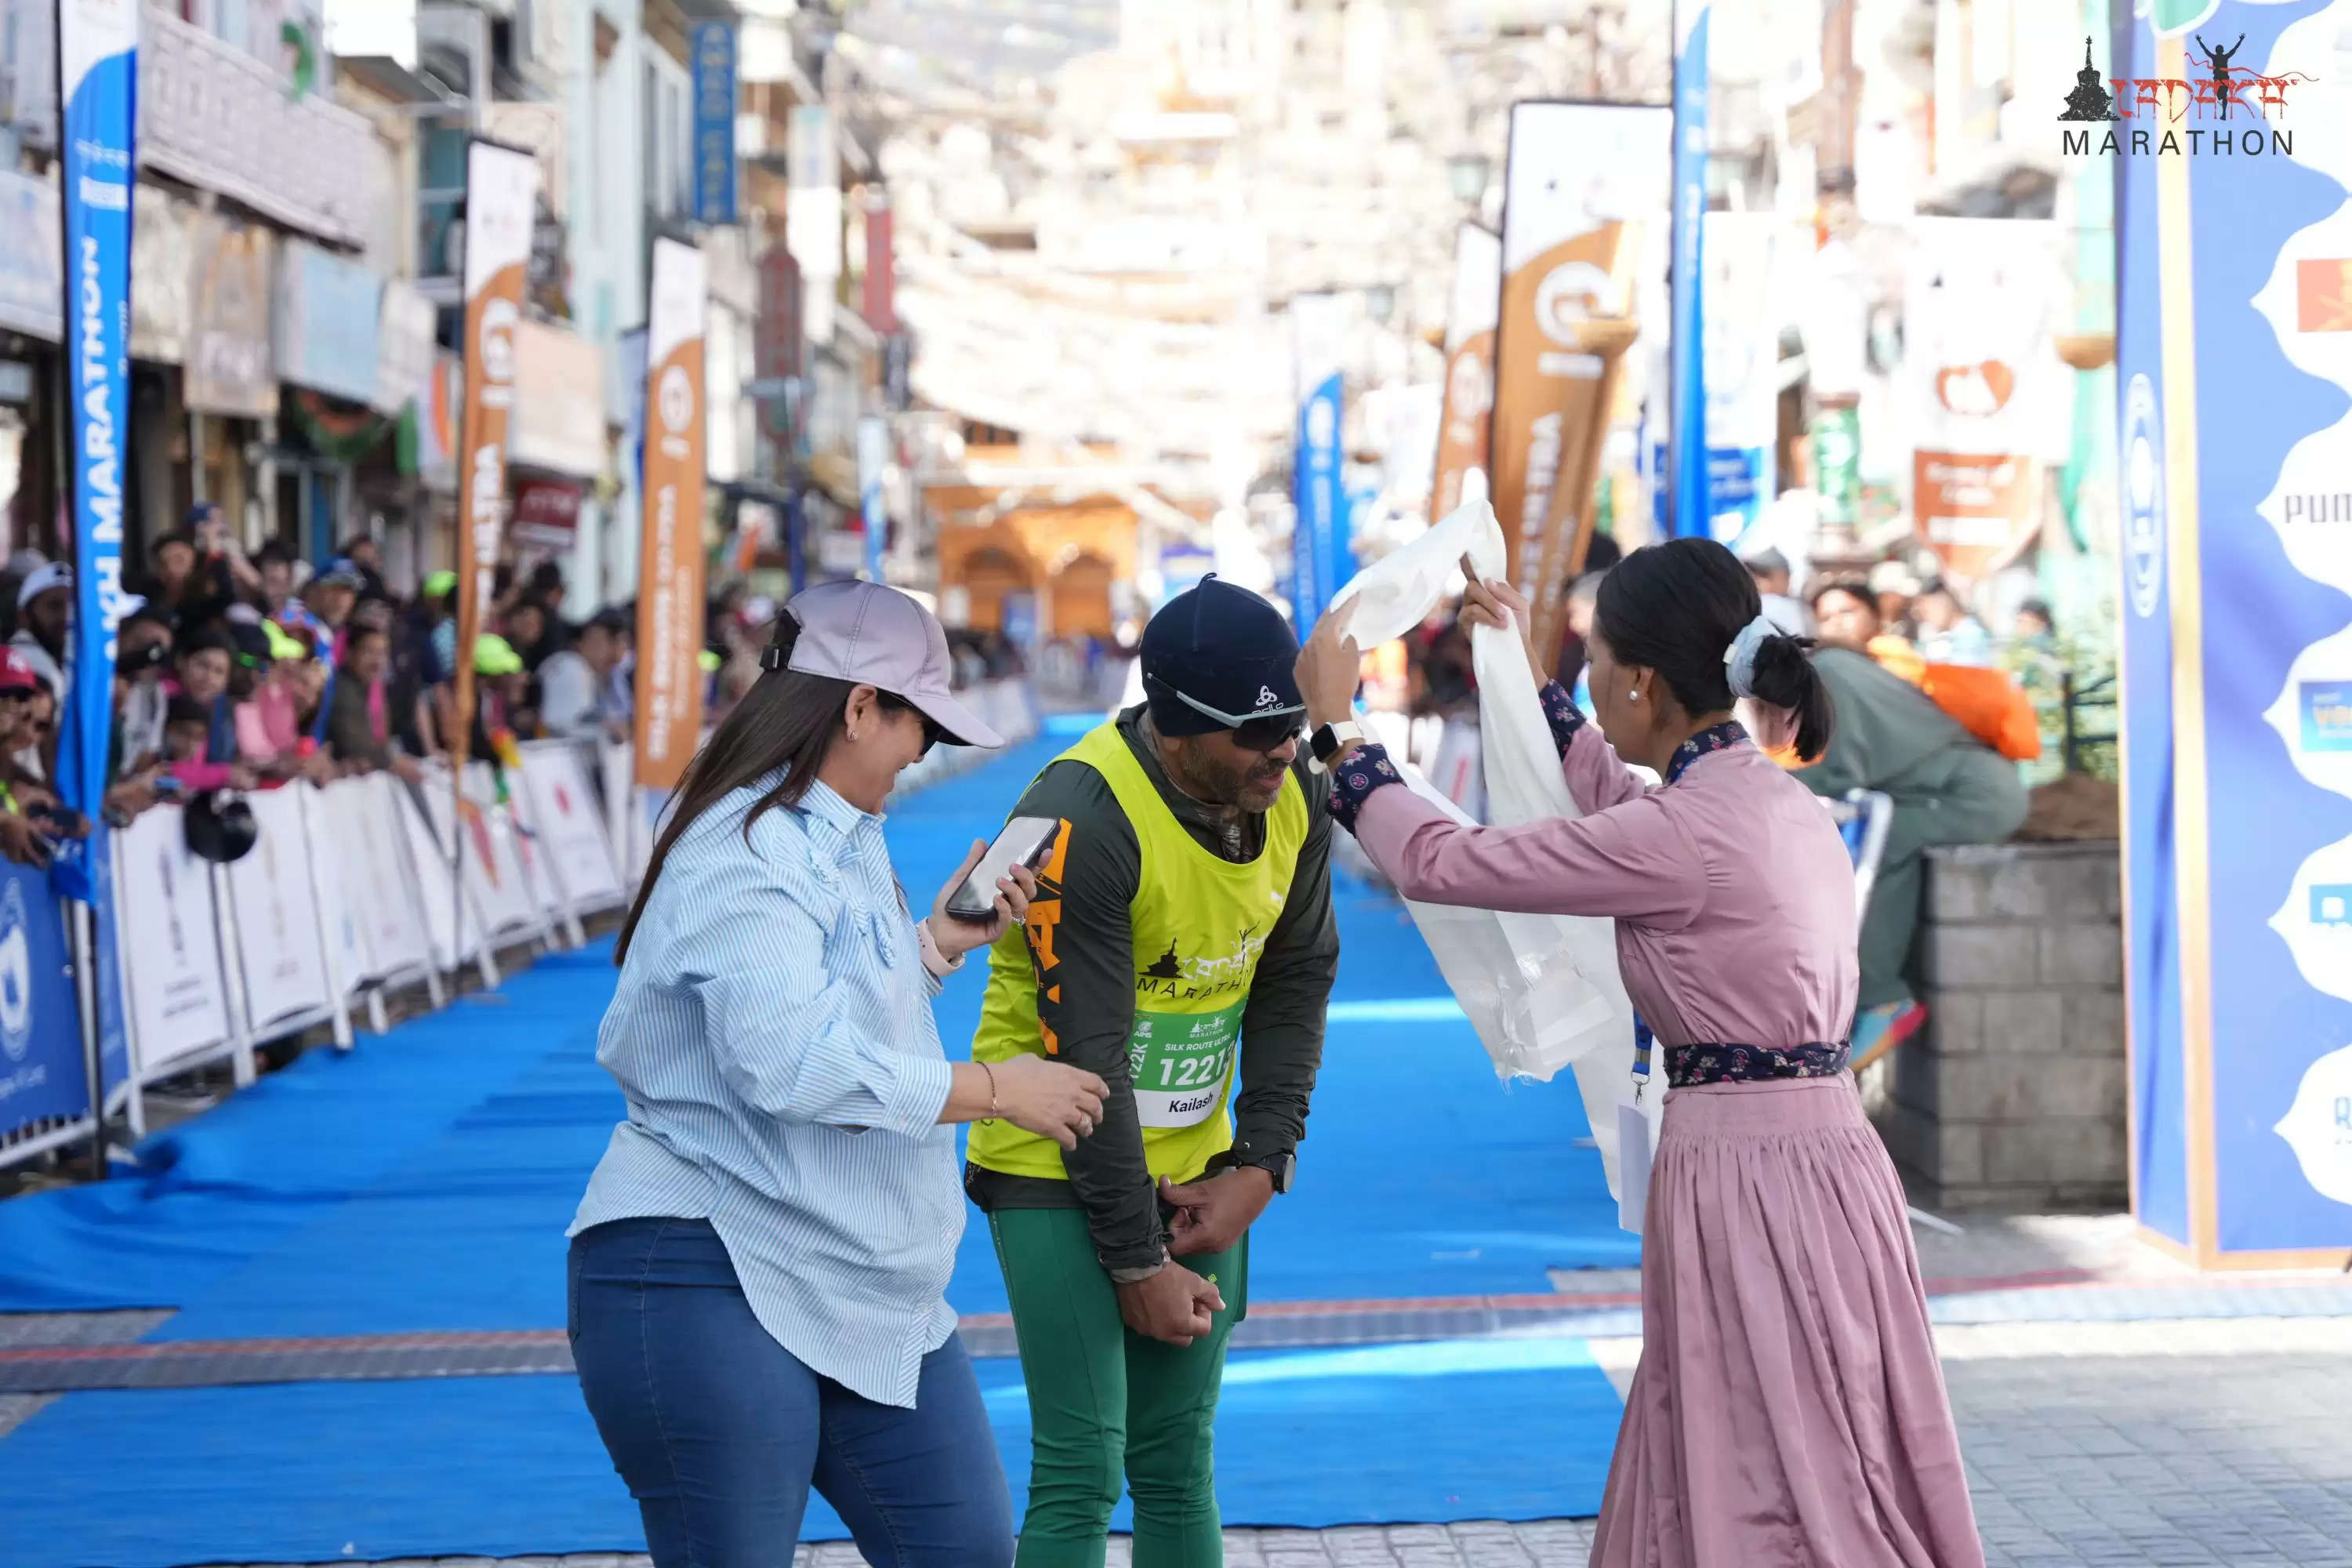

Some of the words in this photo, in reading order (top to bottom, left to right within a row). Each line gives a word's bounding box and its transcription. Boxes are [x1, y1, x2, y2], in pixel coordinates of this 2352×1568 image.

[81, 236, 124, 544] MARATHON
[1186, 1041, 1213, 1051] ROUTE
[1169, 1091, 1214, 1112] Kailash
